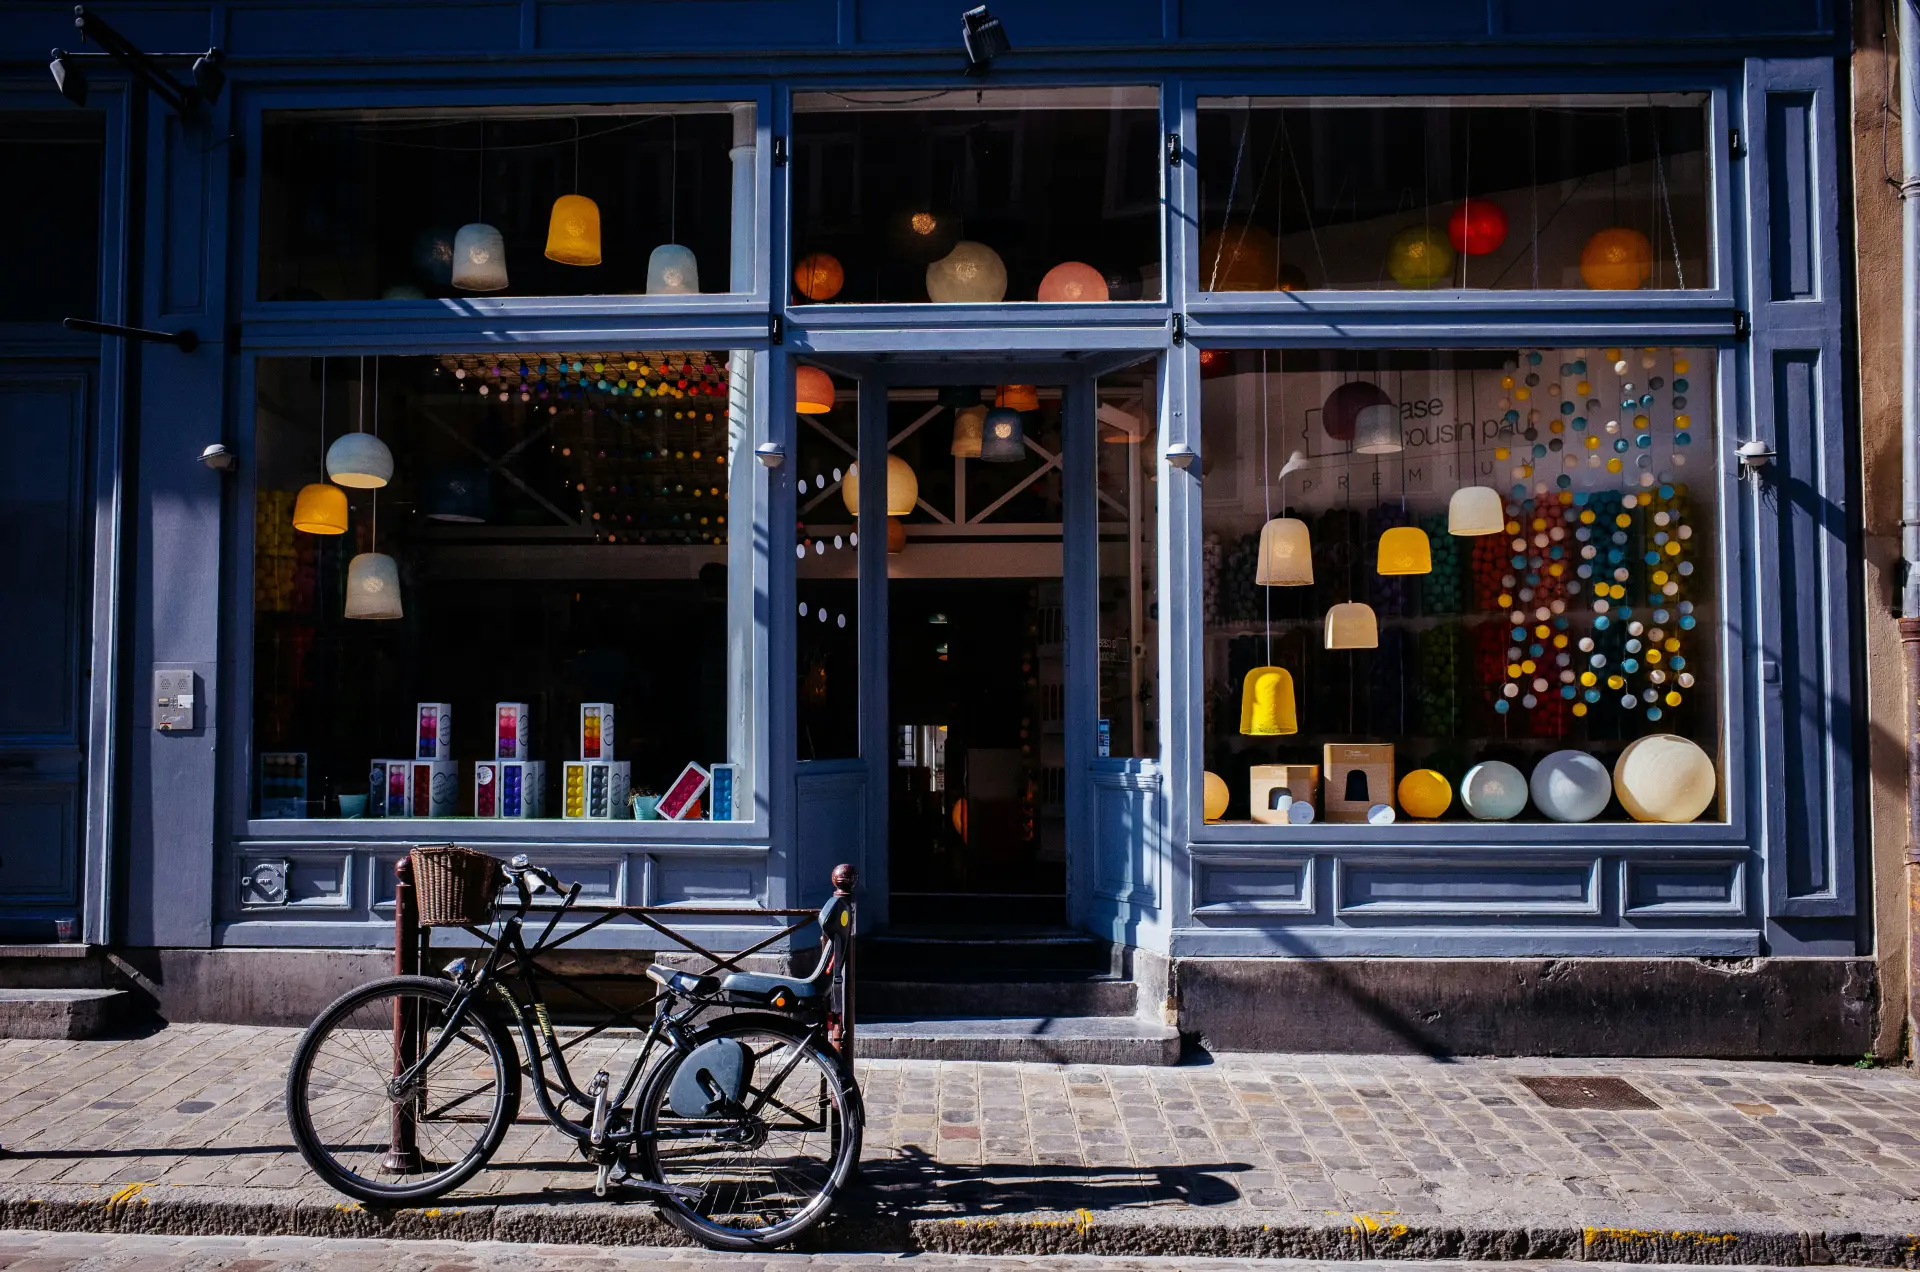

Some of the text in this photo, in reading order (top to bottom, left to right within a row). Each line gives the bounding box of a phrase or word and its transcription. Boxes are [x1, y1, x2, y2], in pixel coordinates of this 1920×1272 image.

[1400, 398, 1443, 419] ase
[1405, 418, 1475, 447] ousin
[1303, 457, 1536, 493] PREMIUM
